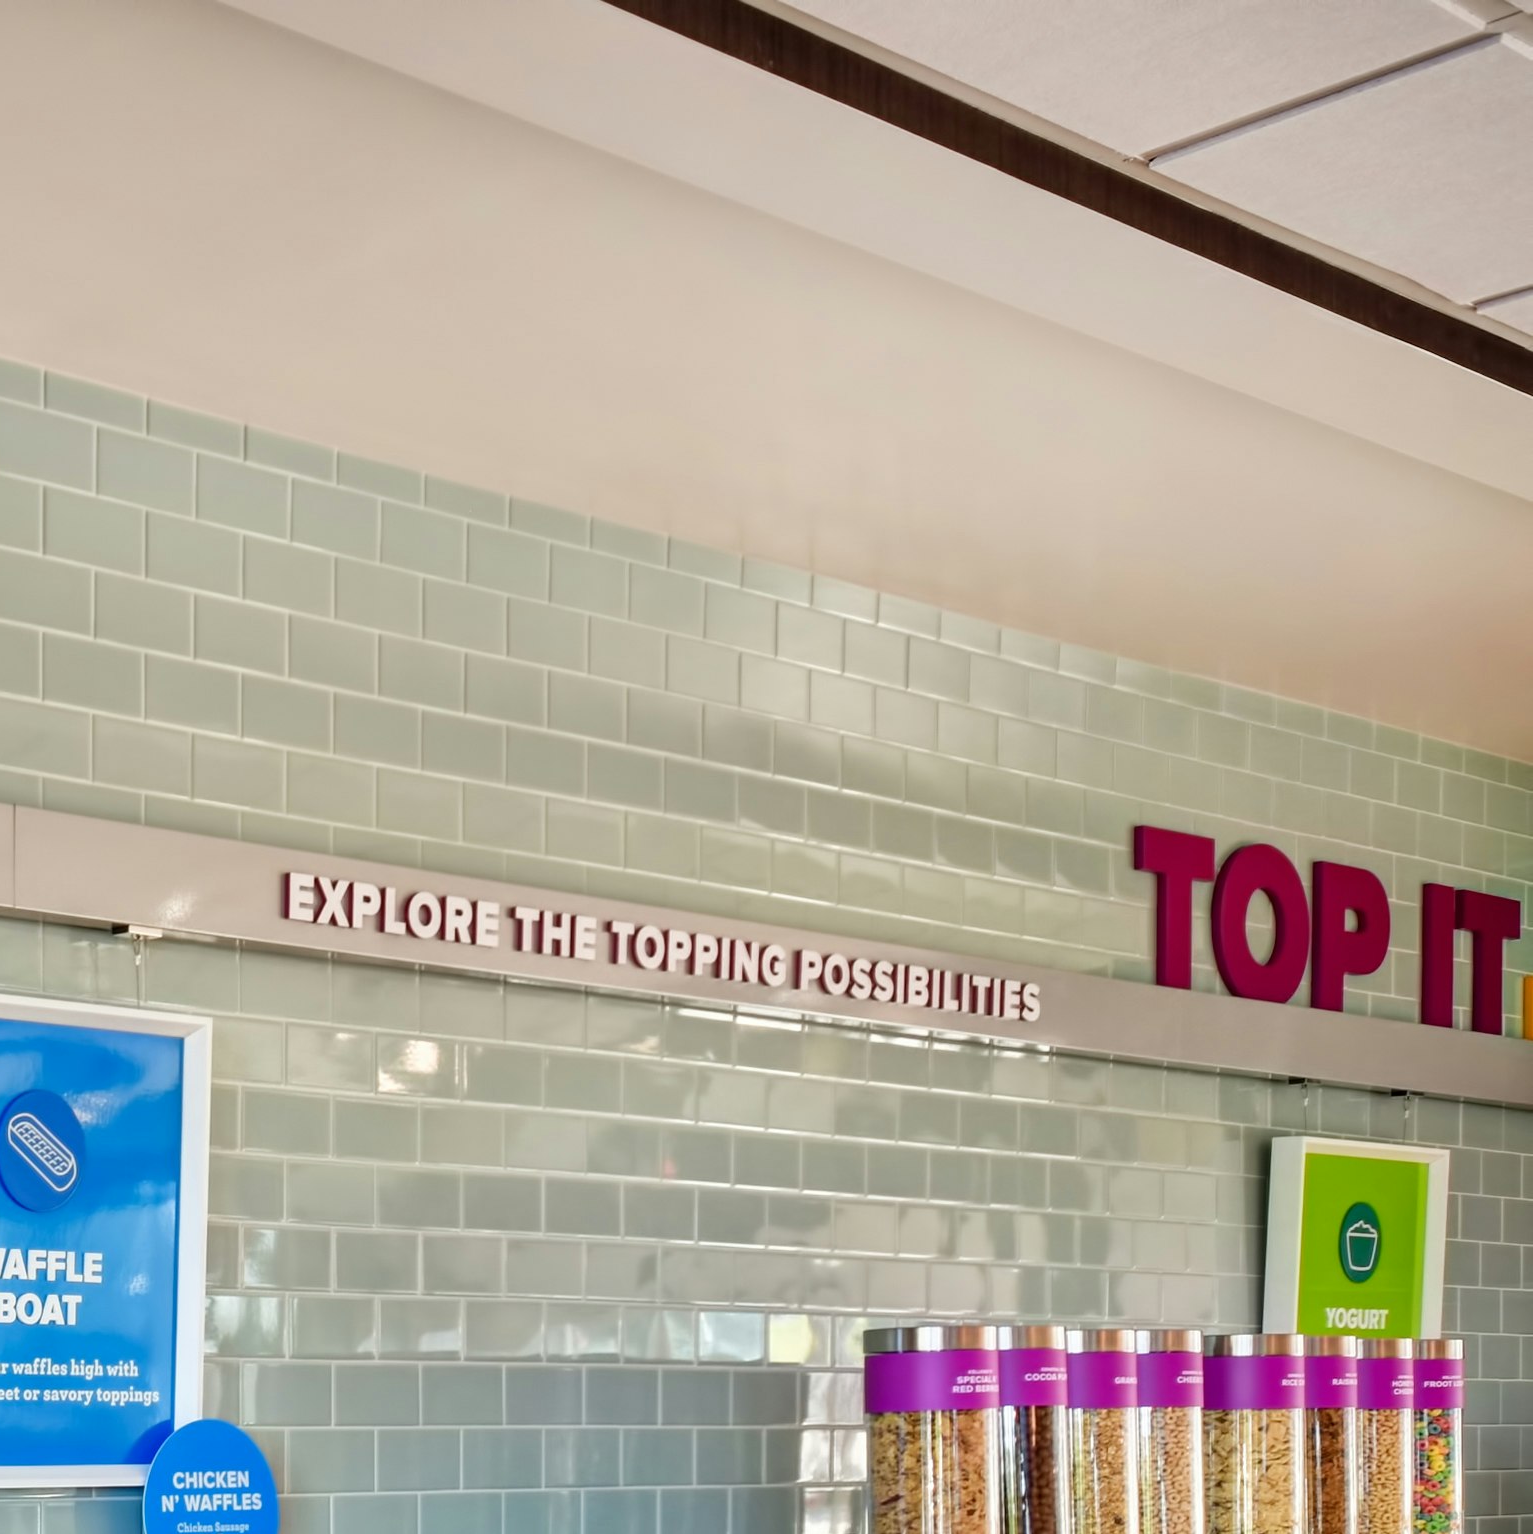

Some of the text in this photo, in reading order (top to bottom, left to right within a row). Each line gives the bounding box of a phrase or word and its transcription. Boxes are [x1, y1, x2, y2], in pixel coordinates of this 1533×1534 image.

[1134, 825, 1521, 1035] TOP IT
[285, 872, 1041, 1022] EXPLORE THE TOPPING POSSIBILITIES
[1325, 1307, 1389, 1330] YOGURT
[12, 1358, 67, 1376] waffles
[70, 1359, 103, 1380] high
[106, 1361, 139, 1377] with
[1024, 1373, 1057, 1381] COCOA
[23, 1388, 40, 1401] or
[43, 1389, 94, 1405] savory
[97, 1386, 159, 1406] toppings
[952, 1385, 973, 1393] RED
[172, 1470, 249, 1489] CHICKEN
[184, 1493, 262, 1511] WAFFLES
[177, 1522, 249, 1533] Chicken Sausage
